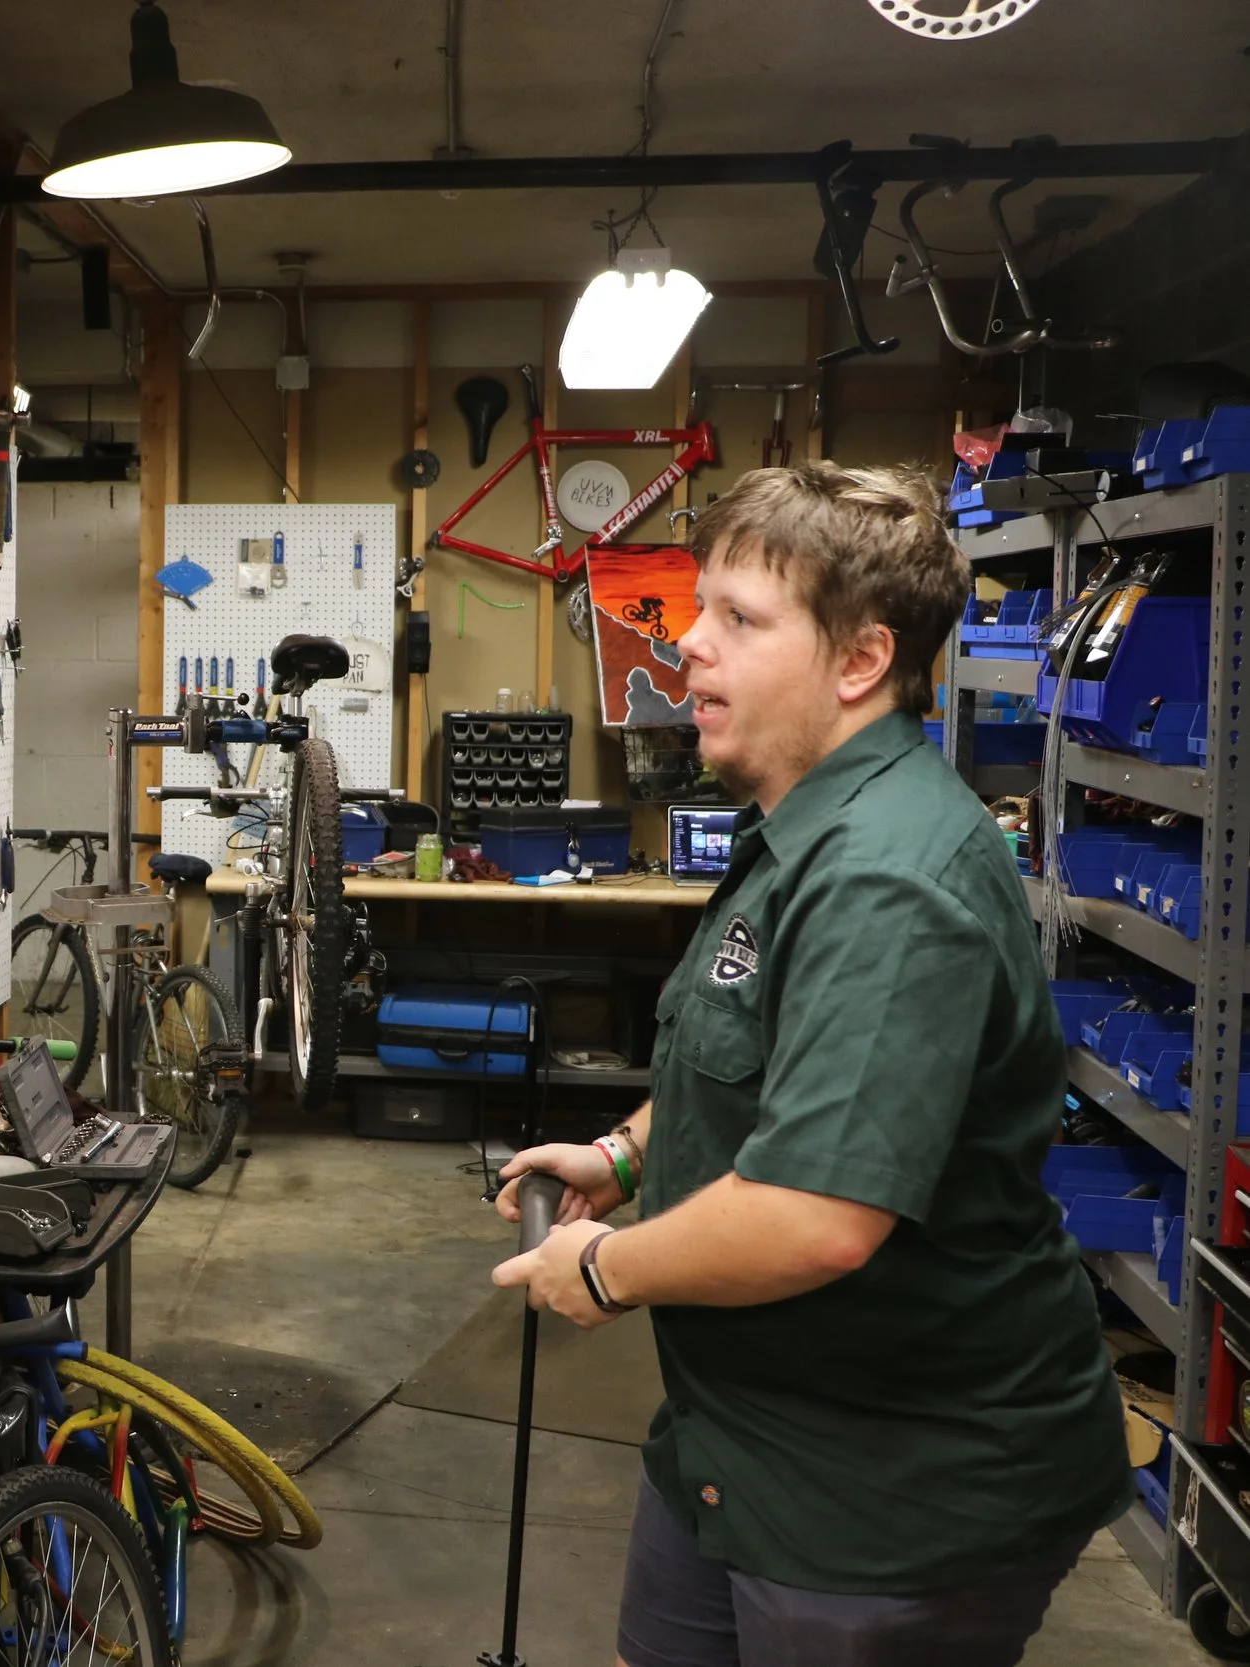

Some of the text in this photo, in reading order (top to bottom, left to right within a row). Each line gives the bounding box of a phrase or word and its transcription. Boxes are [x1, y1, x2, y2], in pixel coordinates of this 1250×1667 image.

[633, 430, 670, 443] XRL
[580, 478, 614, 498] UVM
[571, 488, 611, 508] BIKES
[349, 654, 371, 670] UST
[134, 723, 157, 731] Park
